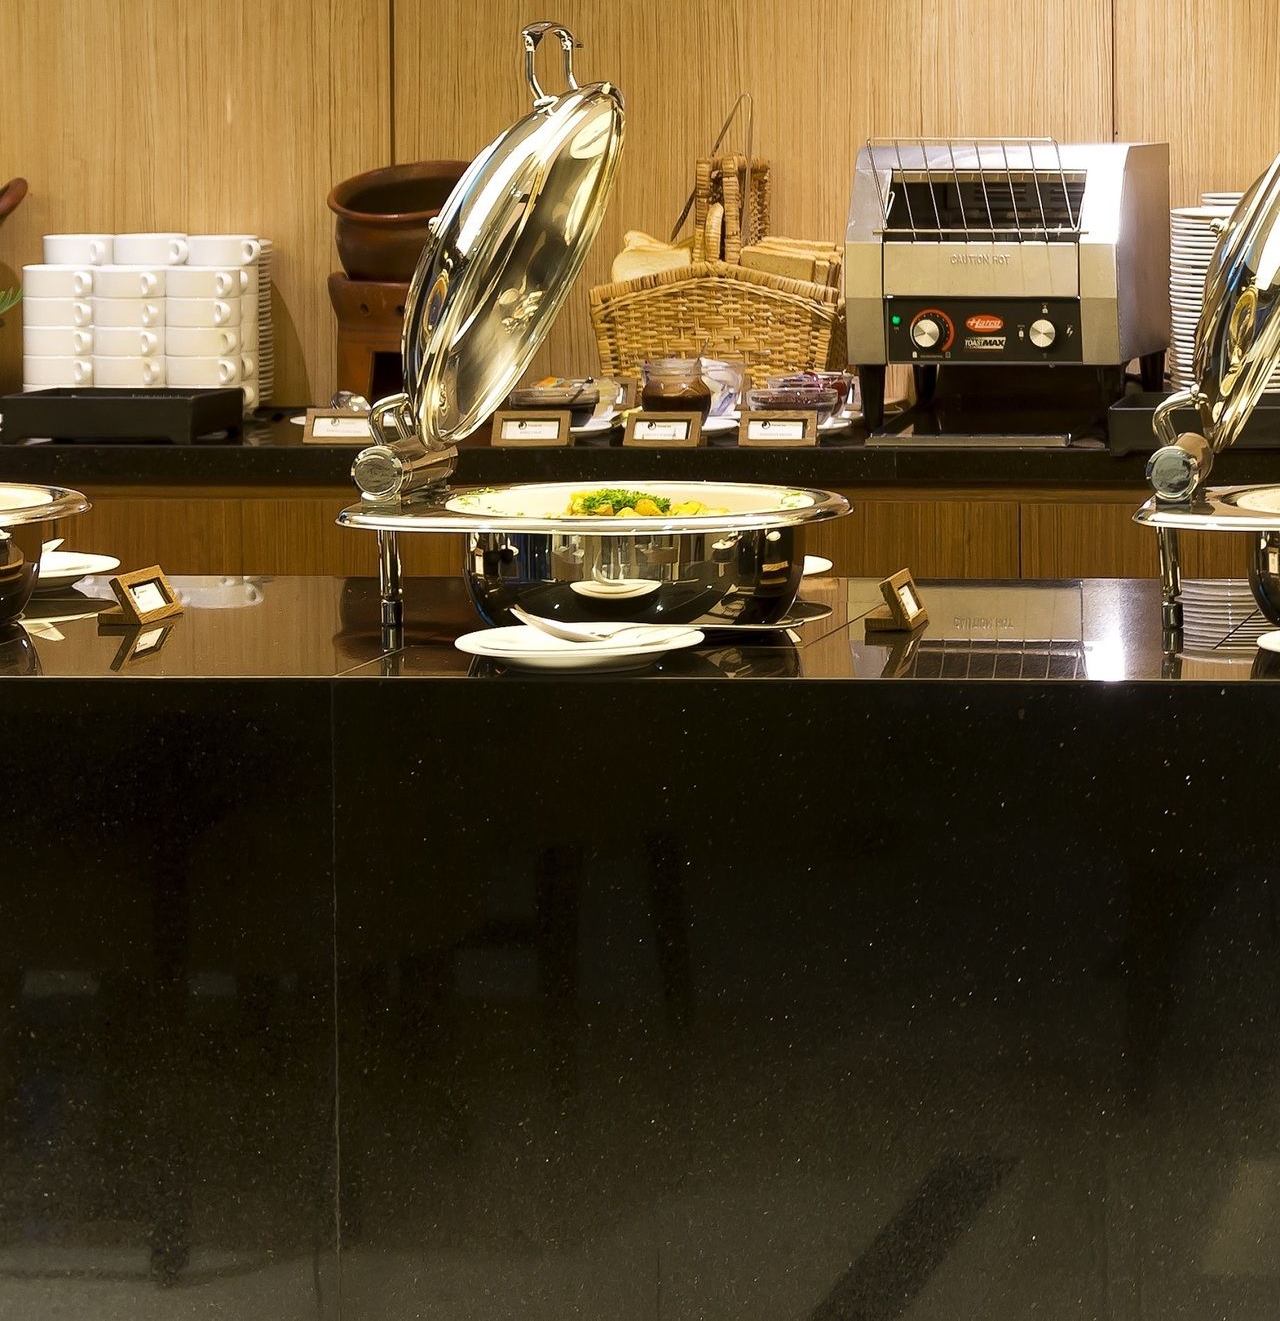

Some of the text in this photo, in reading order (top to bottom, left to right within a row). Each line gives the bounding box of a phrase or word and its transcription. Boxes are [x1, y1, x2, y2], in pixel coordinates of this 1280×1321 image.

[950, 254, 1011, 265] CAUTION HOT
[967, 317, 1002, 329] Hatco
